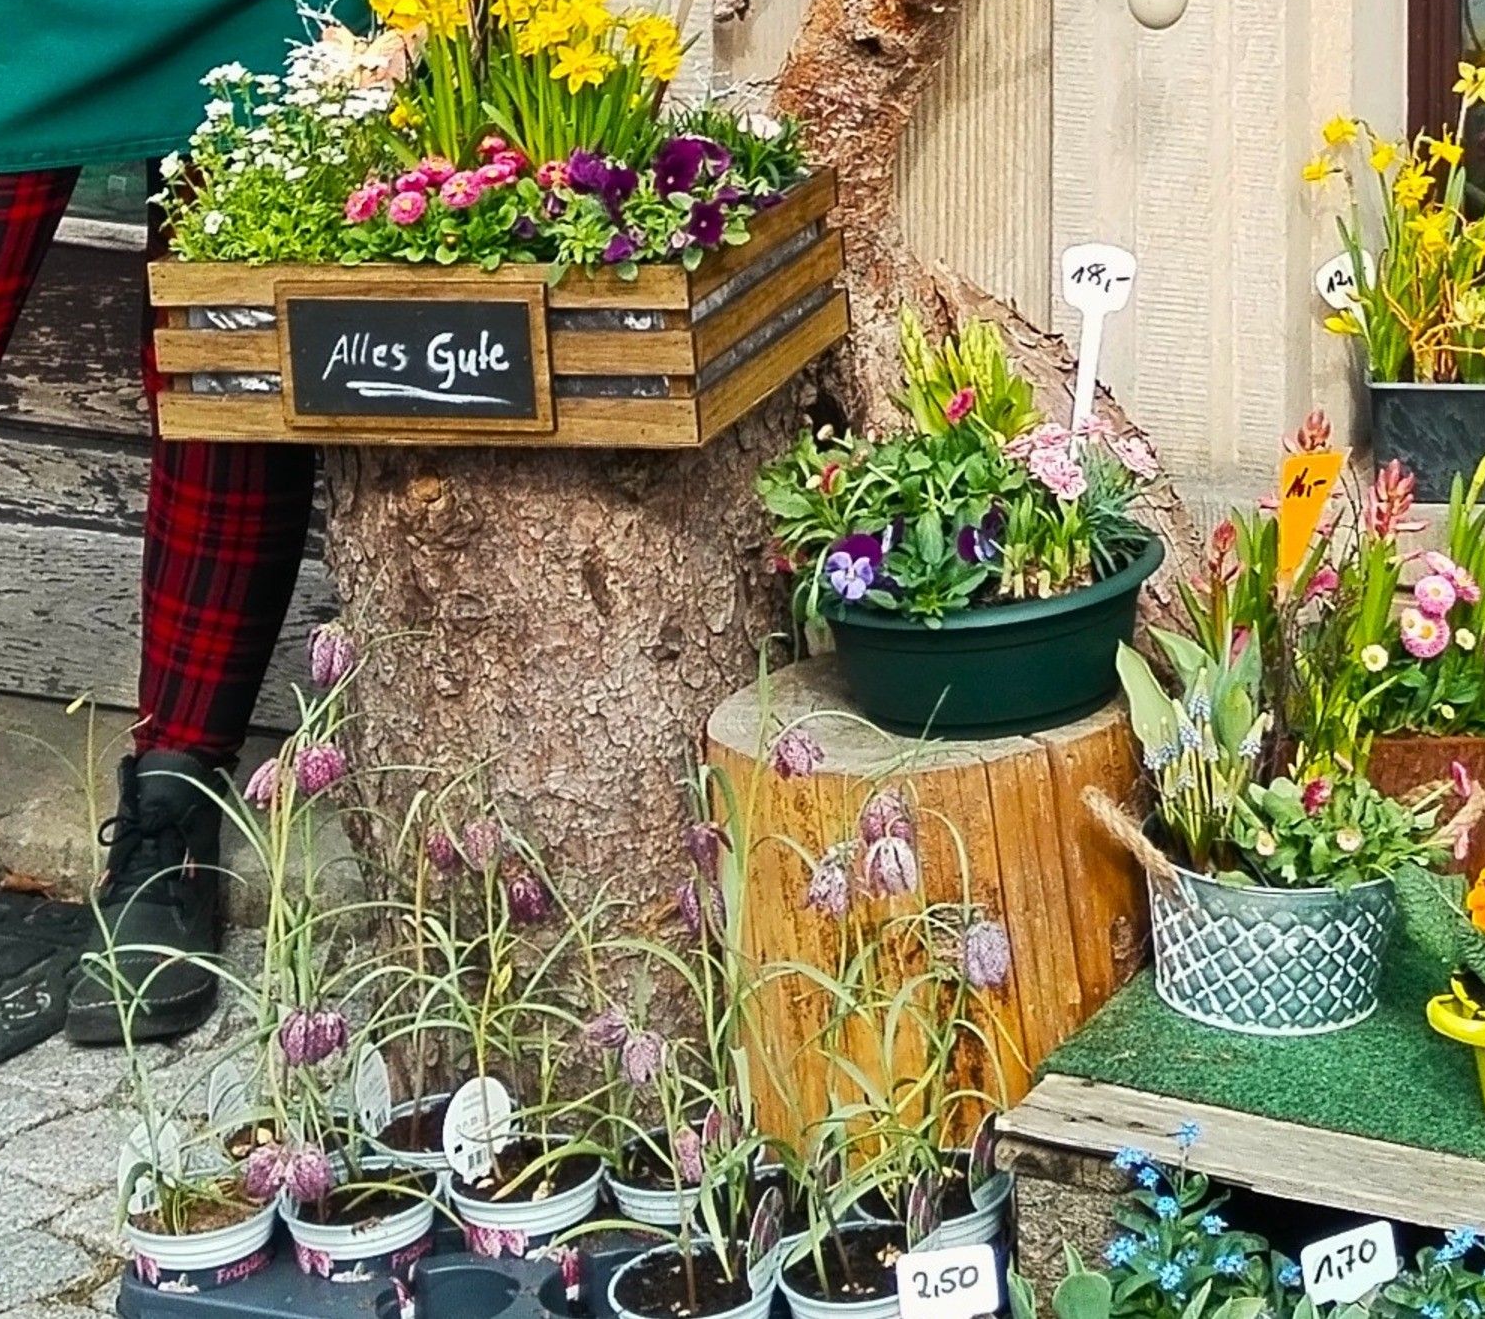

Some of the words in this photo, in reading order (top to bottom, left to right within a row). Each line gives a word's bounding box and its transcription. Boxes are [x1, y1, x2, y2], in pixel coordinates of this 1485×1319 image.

[1327, 266, 1366, 293] 12,
[322, 332, 408, 381] Alles
[427, 330, 510, 389] Gute
[1314, 1238, 1377, 1284] 1,70
[912, 1265, 979, 1299] 2,50
